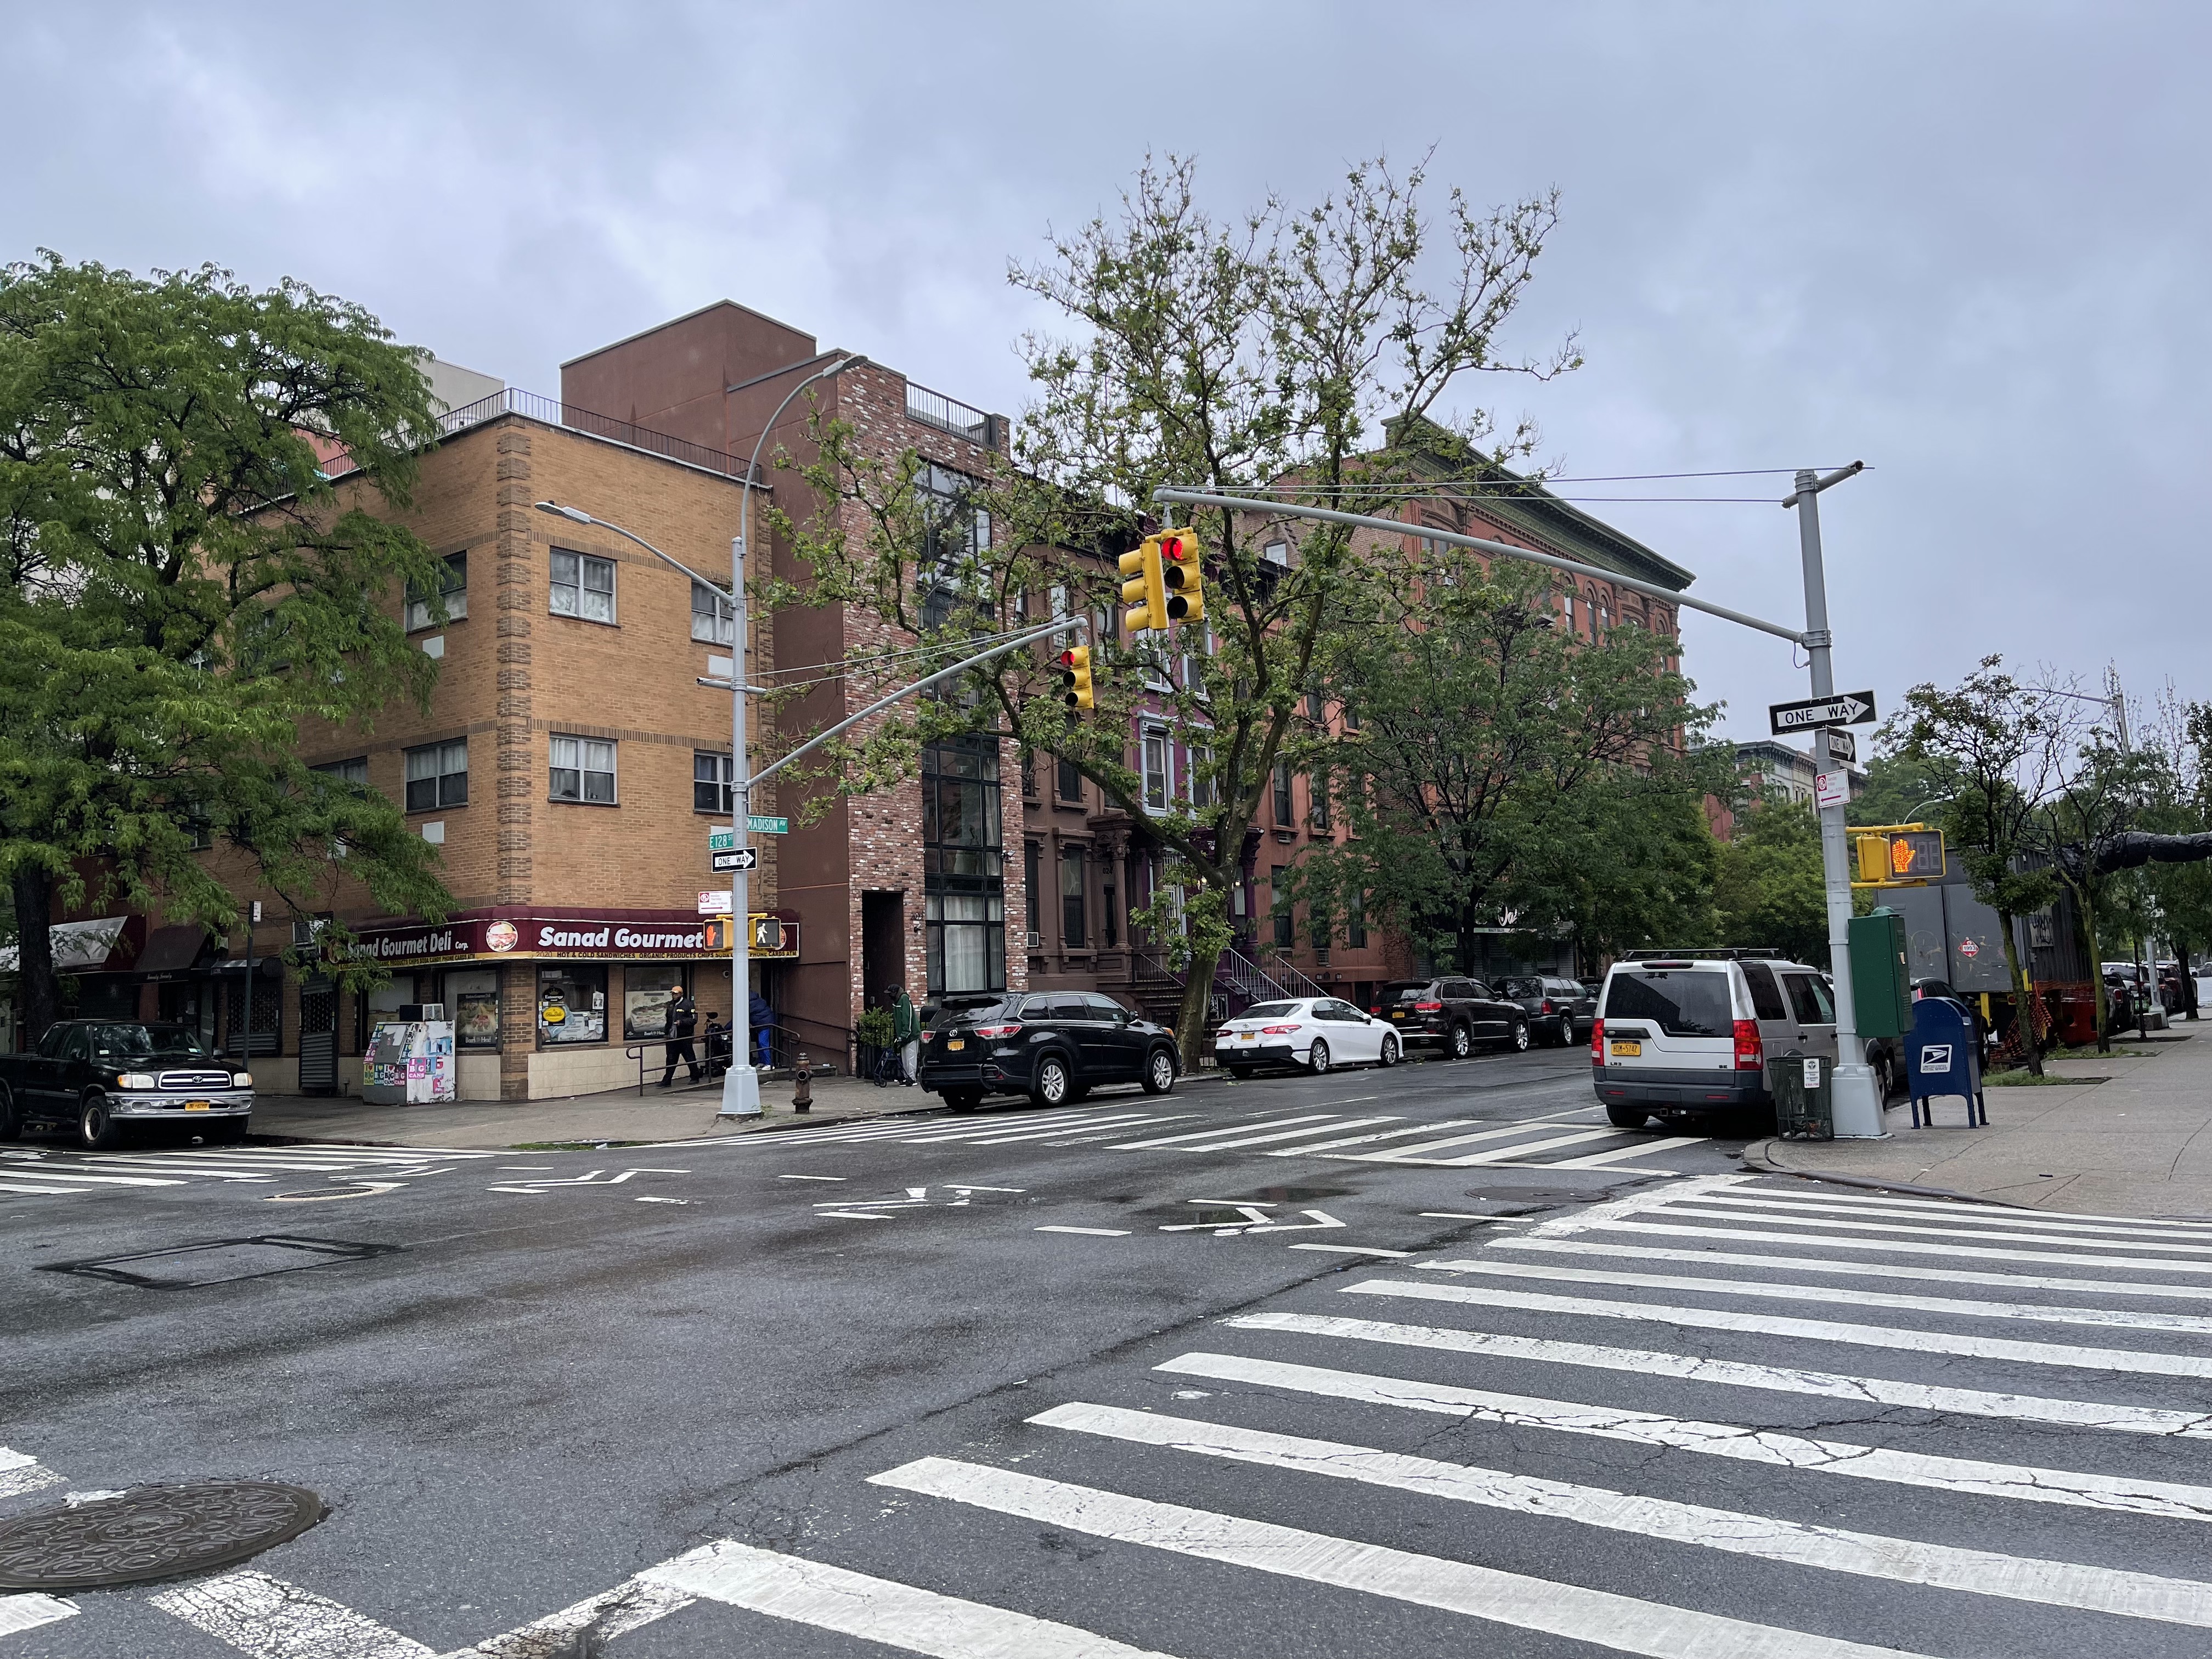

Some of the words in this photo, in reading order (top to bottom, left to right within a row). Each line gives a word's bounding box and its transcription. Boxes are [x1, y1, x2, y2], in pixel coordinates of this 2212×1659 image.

[1785, 709, 1814, 724] ONE
[1827, 703, 1858, 718] WAY
[1831, 737, 1840, 751] ONE
[1843, 741, 1851, 754] WAY
[748, 817, 778, 831] MADISON
[709, 837, 714, 848] E
[715, 835, 727, 848] 128
[718, 857, 731, 866] ONE
[736, 855, 750, 864] WAY
[381, 935, 428, 956] Gourmet
[430, 930, 452, 953] Deli
[455, 941, 469, 950] Corp.
[538, 926, 610, 947] Sanad
[614, 928, 703, 948] Gourmet
